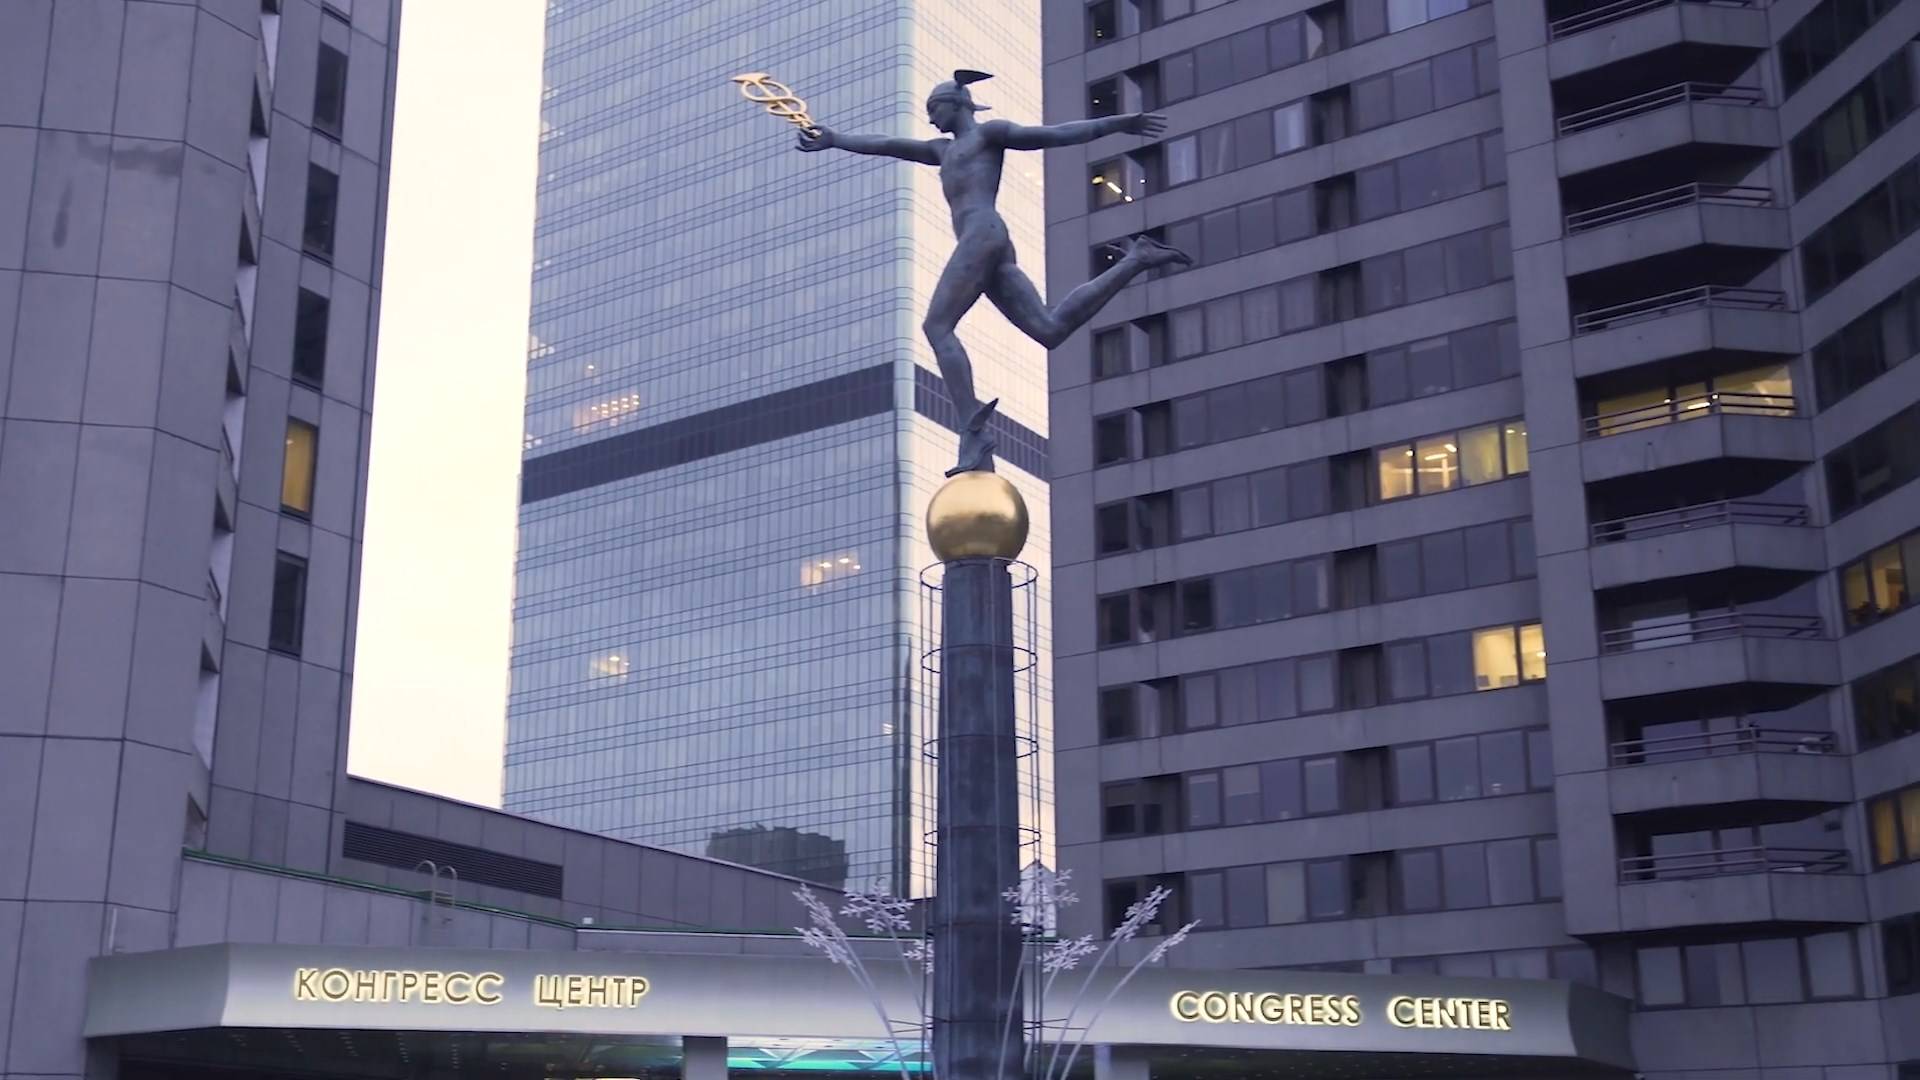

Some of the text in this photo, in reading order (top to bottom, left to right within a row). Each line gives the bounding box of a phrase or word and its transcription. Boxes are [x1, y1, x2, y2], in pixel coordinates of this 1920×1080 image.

[296, 968, 649, 1009] КОНГРЕСС ЦЕНТР
[1171, 990, 1511, 1030] CONGRESS CENTER
